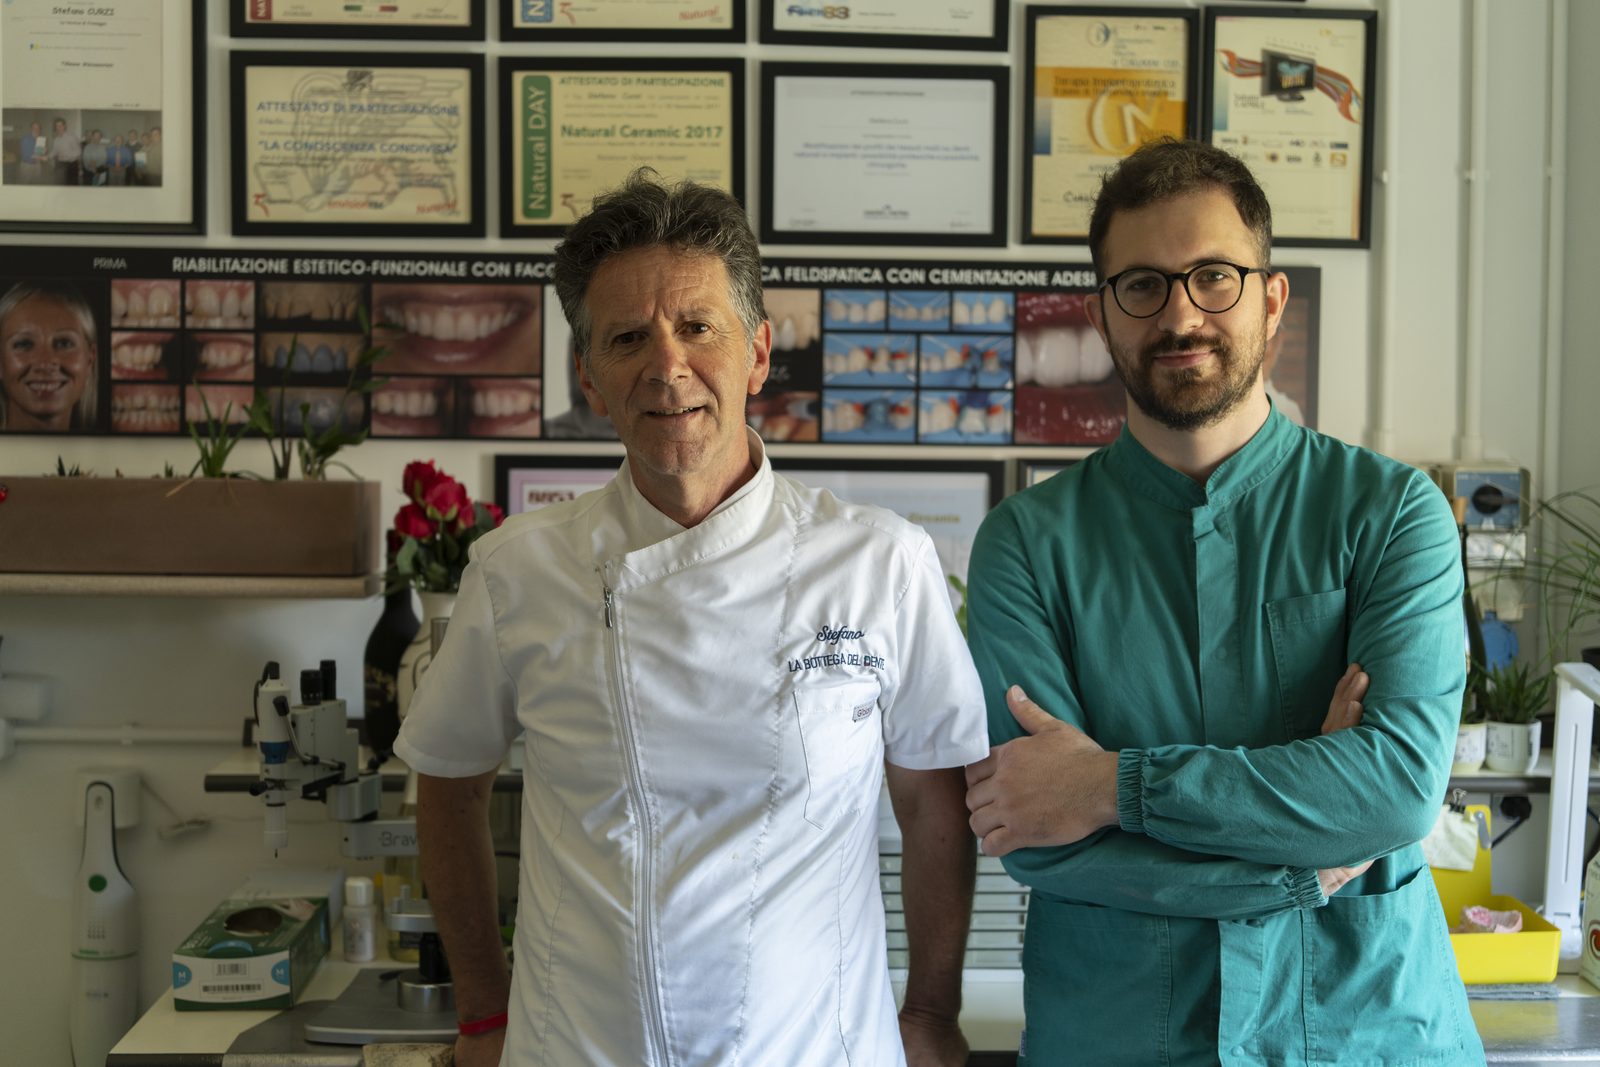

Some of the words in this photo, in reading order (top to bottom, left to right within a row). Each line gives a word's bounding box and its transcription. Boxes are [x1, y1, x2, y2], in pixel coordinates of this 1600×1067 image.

[559, 76, 616, 88] ATTESTATO
[620, 78, 634, 87] DI
[636, 78, 725, 89] PARTECIPAZIONE
[257, 101, 329, 113] ATTESTATO
[351, 102, 460, 117] PARTECIPAZIONE
[527, 86, 546, 129] DAY
[560, 124, 616, 139] Natural
[619, 125, 681, 139] Ceramic
[685, 126, 724, 139] 2017
[527, 136, 546, 210] Natural
[93, 257, 127, 270] PRIMA
[172, 257, 289, 274] RIABILITAZIONE
[293, 258, 467, 277] ESTETICO-FUNZIONALE
[471, 261, 511, 278] CON
[515, 262, 556, 278] FACC
[761, 266, 782, 282] CA
[784, 266, 884, 283] FELDSPATICA
[886, 267, 926, 284] CON
[928, 268, 1049, 287] CEMENTAZIONE
[1051, 270, 1097, 288] ADESI
[816, 625, 865, 646] Stefano
[788, 660, 802, 673] LA
[803, 653, 847, 671] BOTTEGA
[847, 654, 861, 666] DEL
[381, 830, 417, 847] Brav
